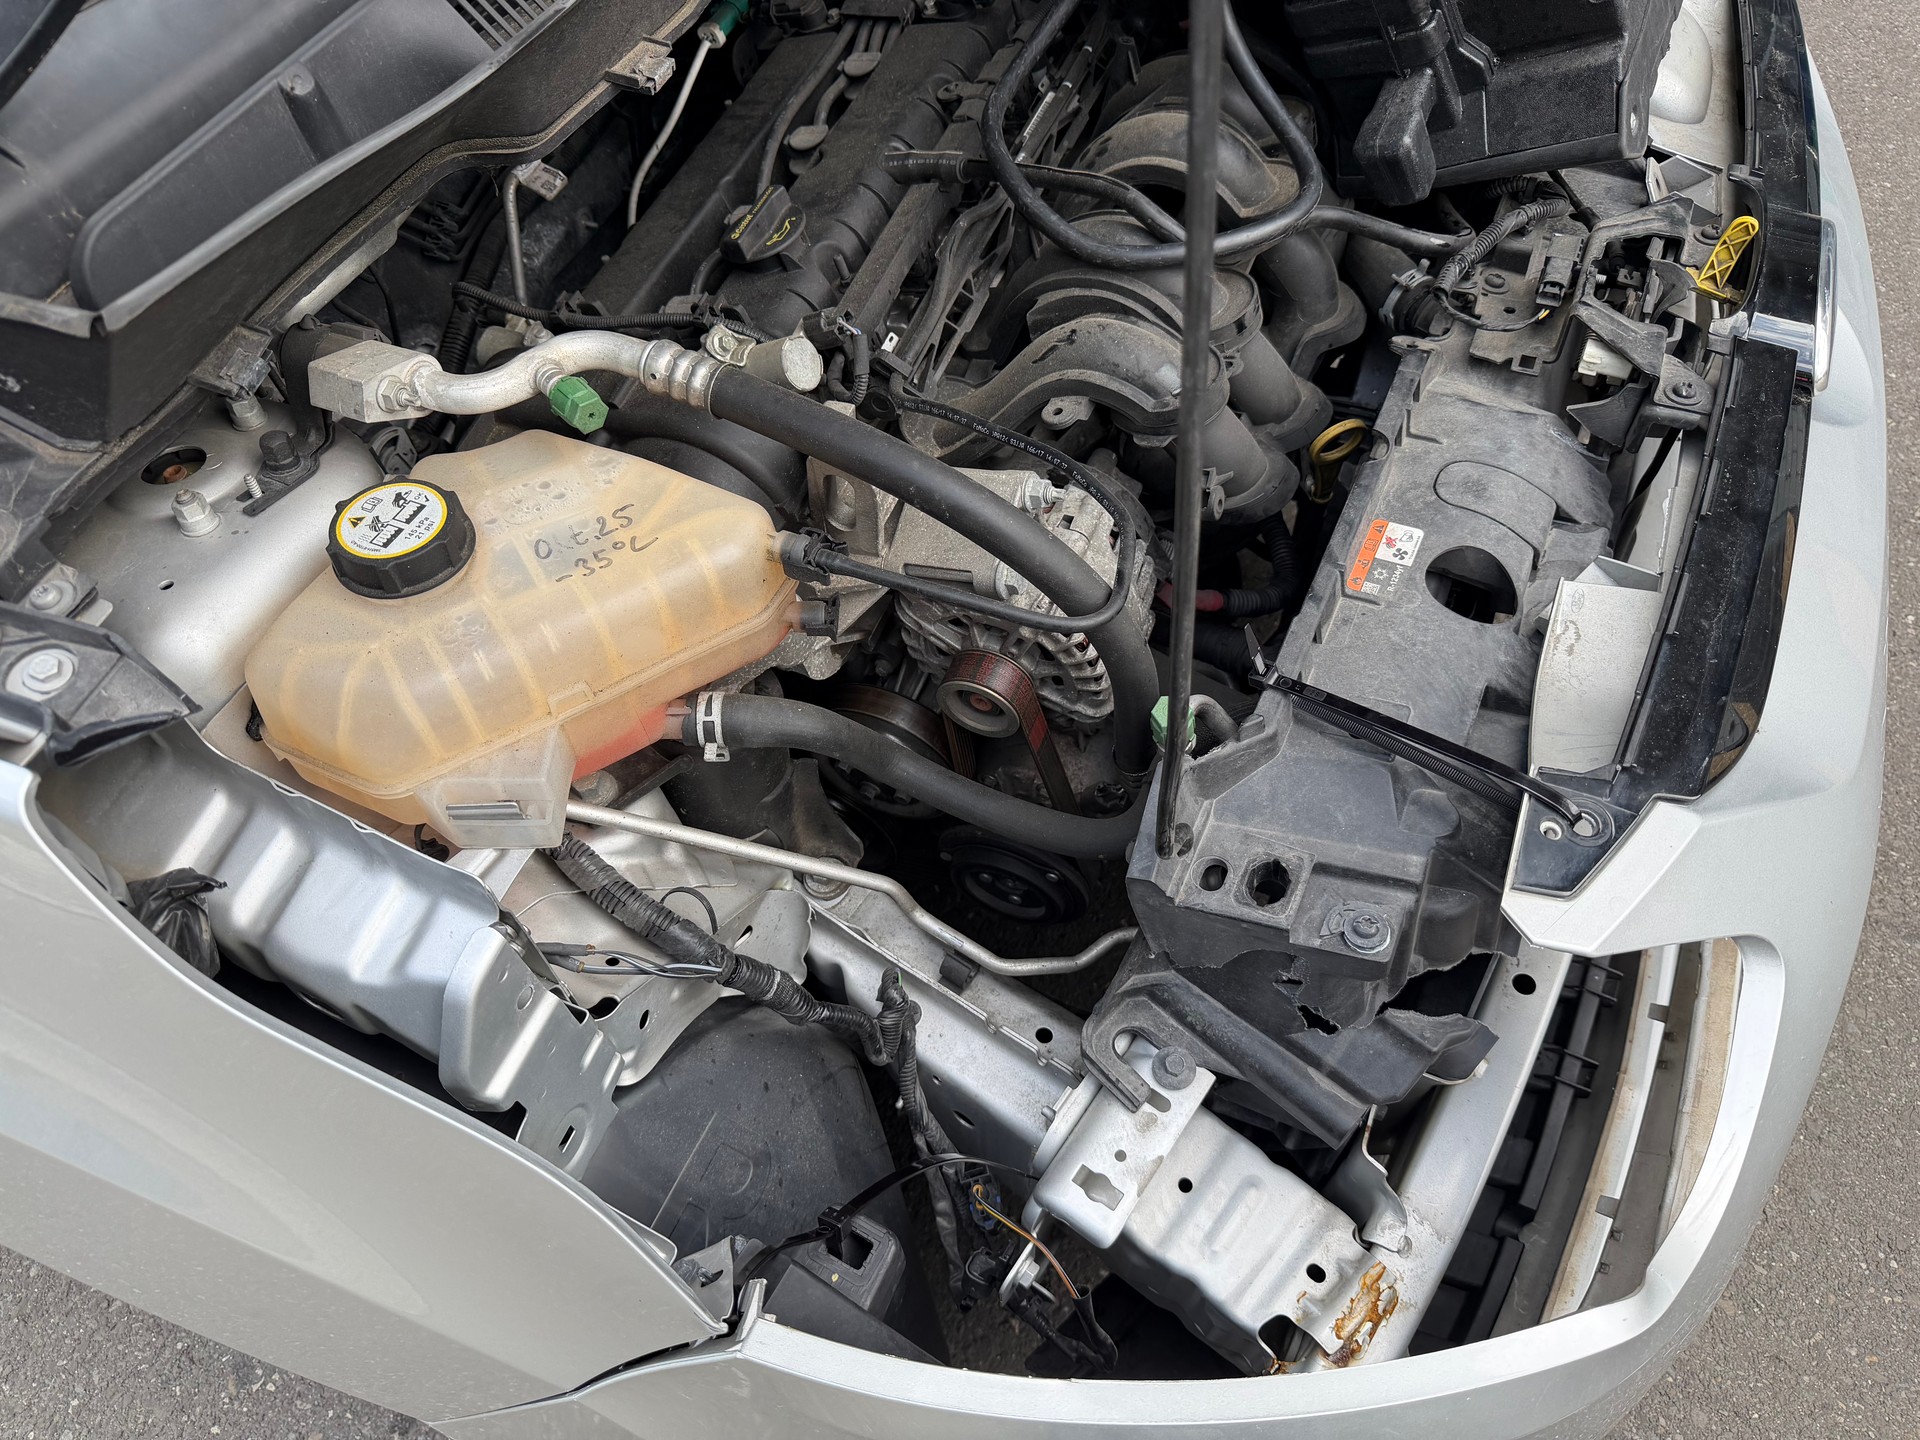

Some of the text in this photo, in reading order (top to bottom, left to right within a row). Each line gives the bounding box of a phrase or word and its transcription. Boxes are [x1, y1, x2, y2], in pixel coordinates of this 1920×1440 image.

[972, 422, 990, 435] FoMoCo
[1026, 445, 1045, 458] 166/17
[413, 491, 424, 501] OK
[404, 516, 430, 541] 145 kPa
[414, 520, 436, 541] 21 psi
